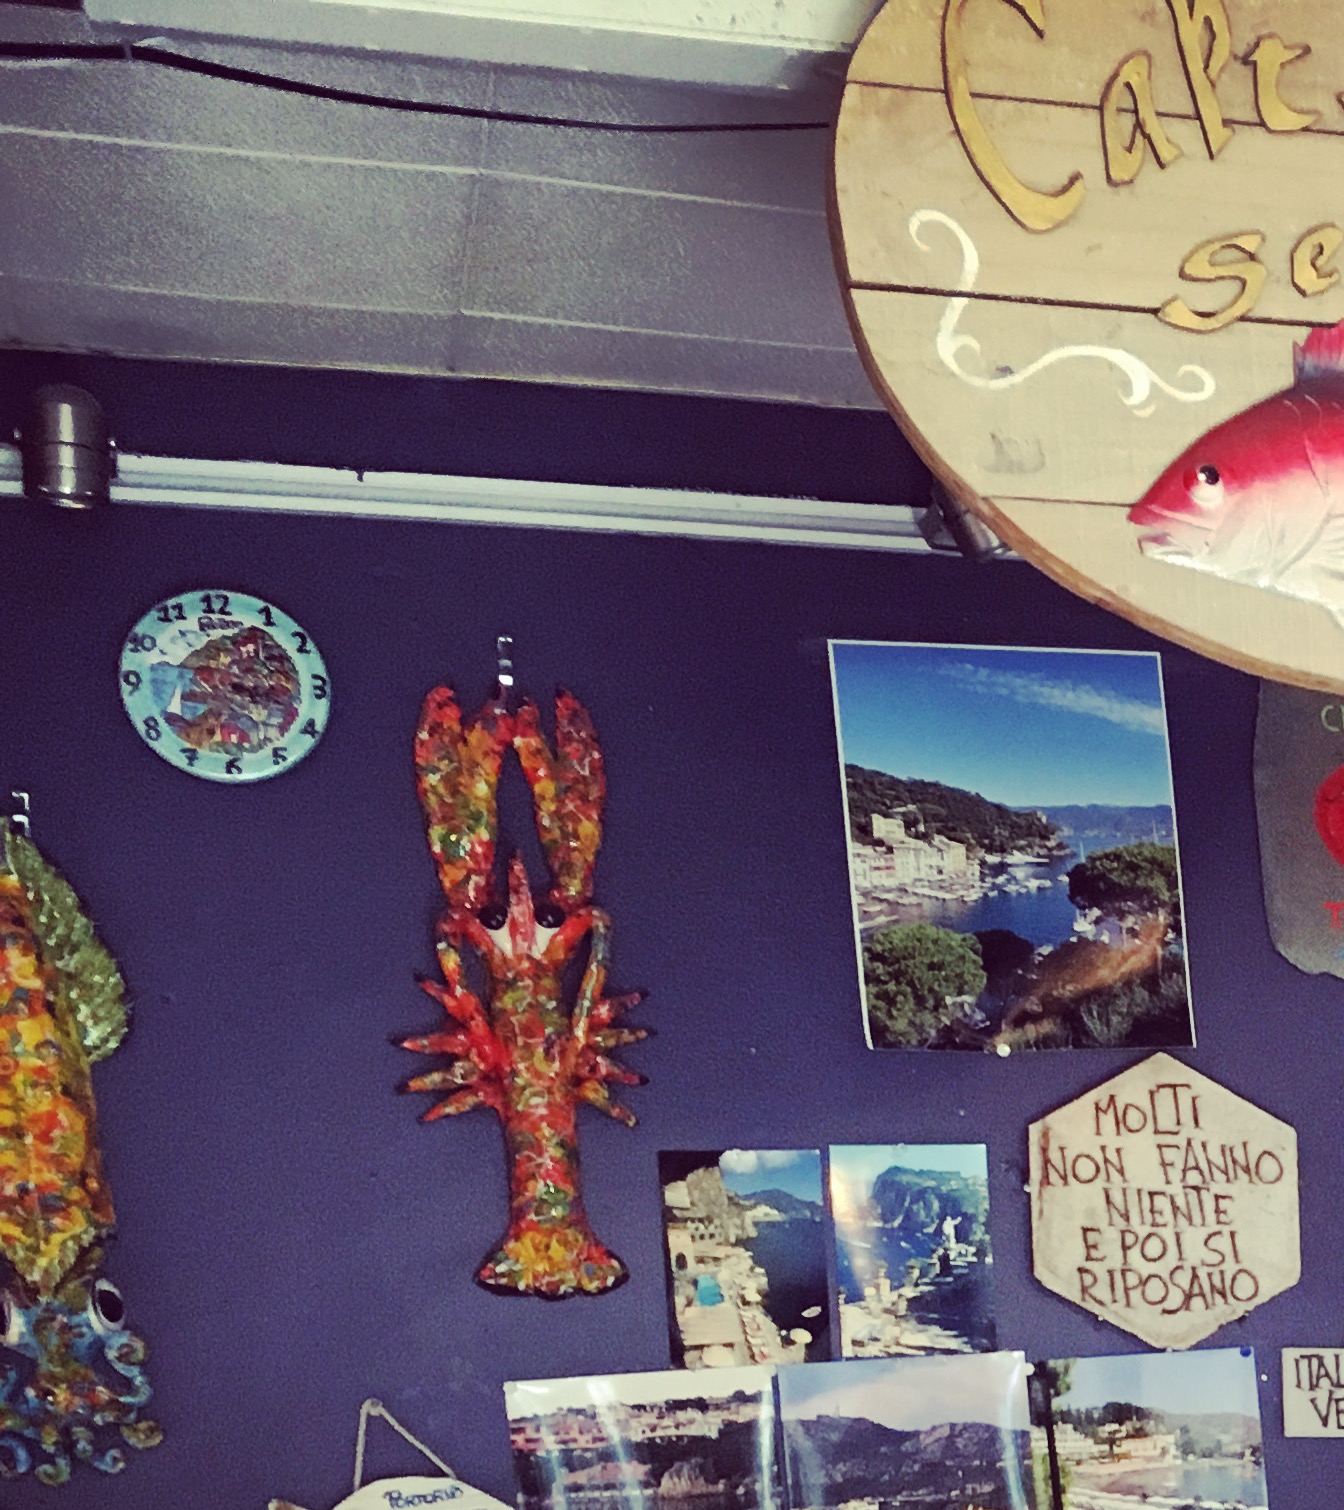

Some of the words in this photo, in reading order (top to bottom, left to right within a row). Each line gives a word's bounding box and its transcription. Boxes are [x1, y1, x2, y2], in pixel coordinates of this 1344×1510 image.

[1095, 1084, 1203, 1136] MOLTI
[1043, 1145, 1130, 1187] NON
[1156, 1138, 1283, 1185] FANNO
[1103, 1185, 1234, 1227] NIENTE
[1081, 1226, 1106, 1262] E
[1120, 1230, 1184, 1264] POI
[1201, 1230, 1242, 1267] SI
[1077, 1265, 1258, 1314] RIPOSANO
